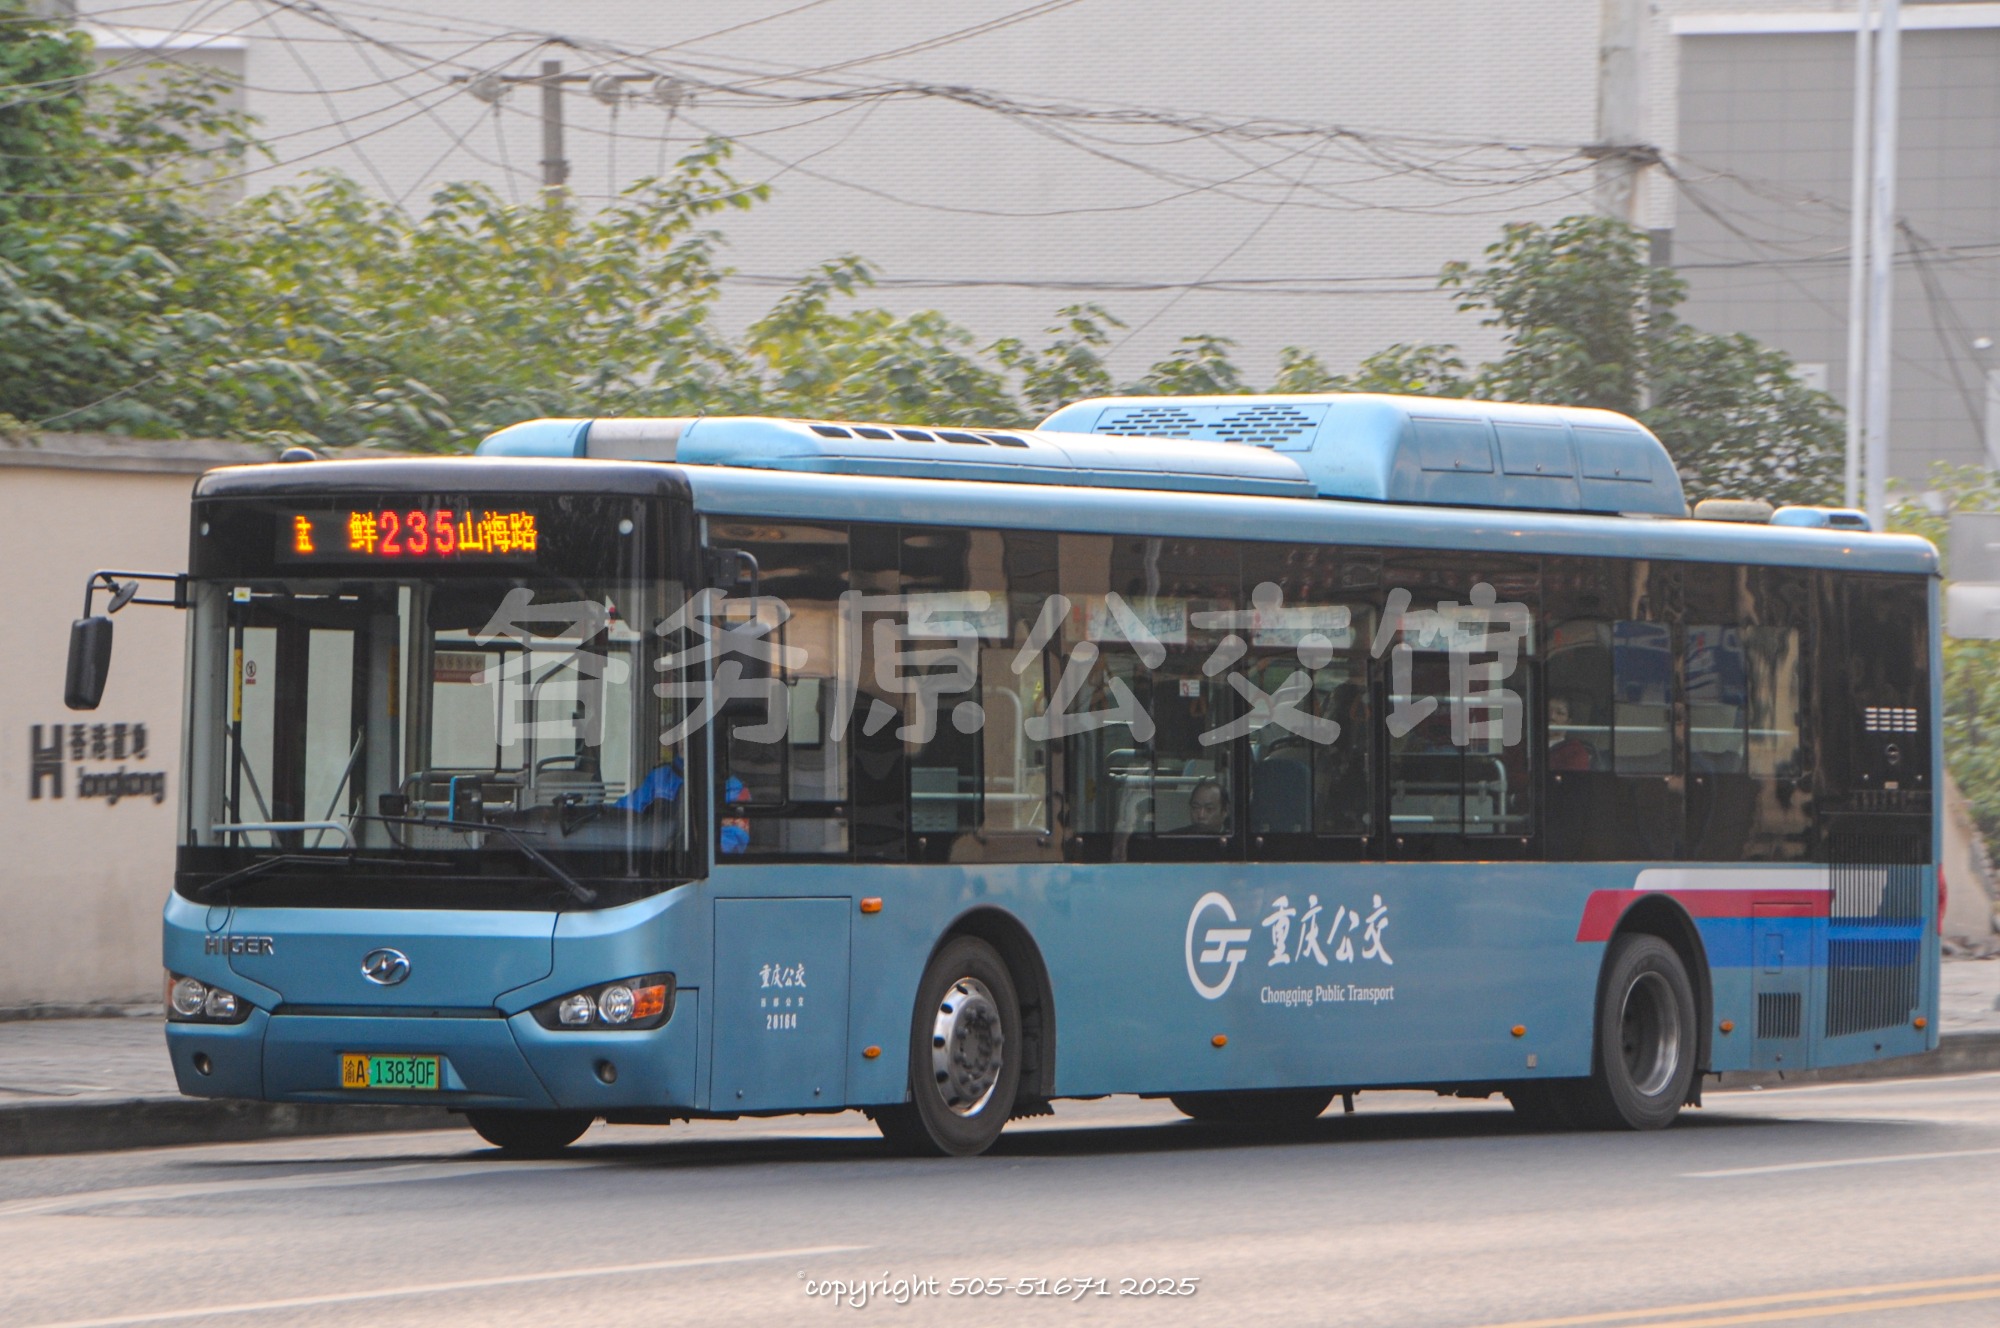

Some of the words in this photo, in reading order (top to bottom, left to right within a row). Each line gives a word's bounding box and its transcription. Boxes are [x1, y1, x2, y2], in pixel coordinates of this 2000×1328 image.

[379, 510, 457, 556] 235
[458, 512, 538, 551] 山海路
[1261, 894, 1394, 967] 重庆公交
[205, 936, 275, 956] HIGER
[759, 963, 807, 988] 重庆公交
[1260, 986, 1313, 1007] Chongqing
[1315, 985, 1345, 1002] Public
[1347, 985, 1394, 1005] Transport
[376, 1060, 436, 1085] 13830F
